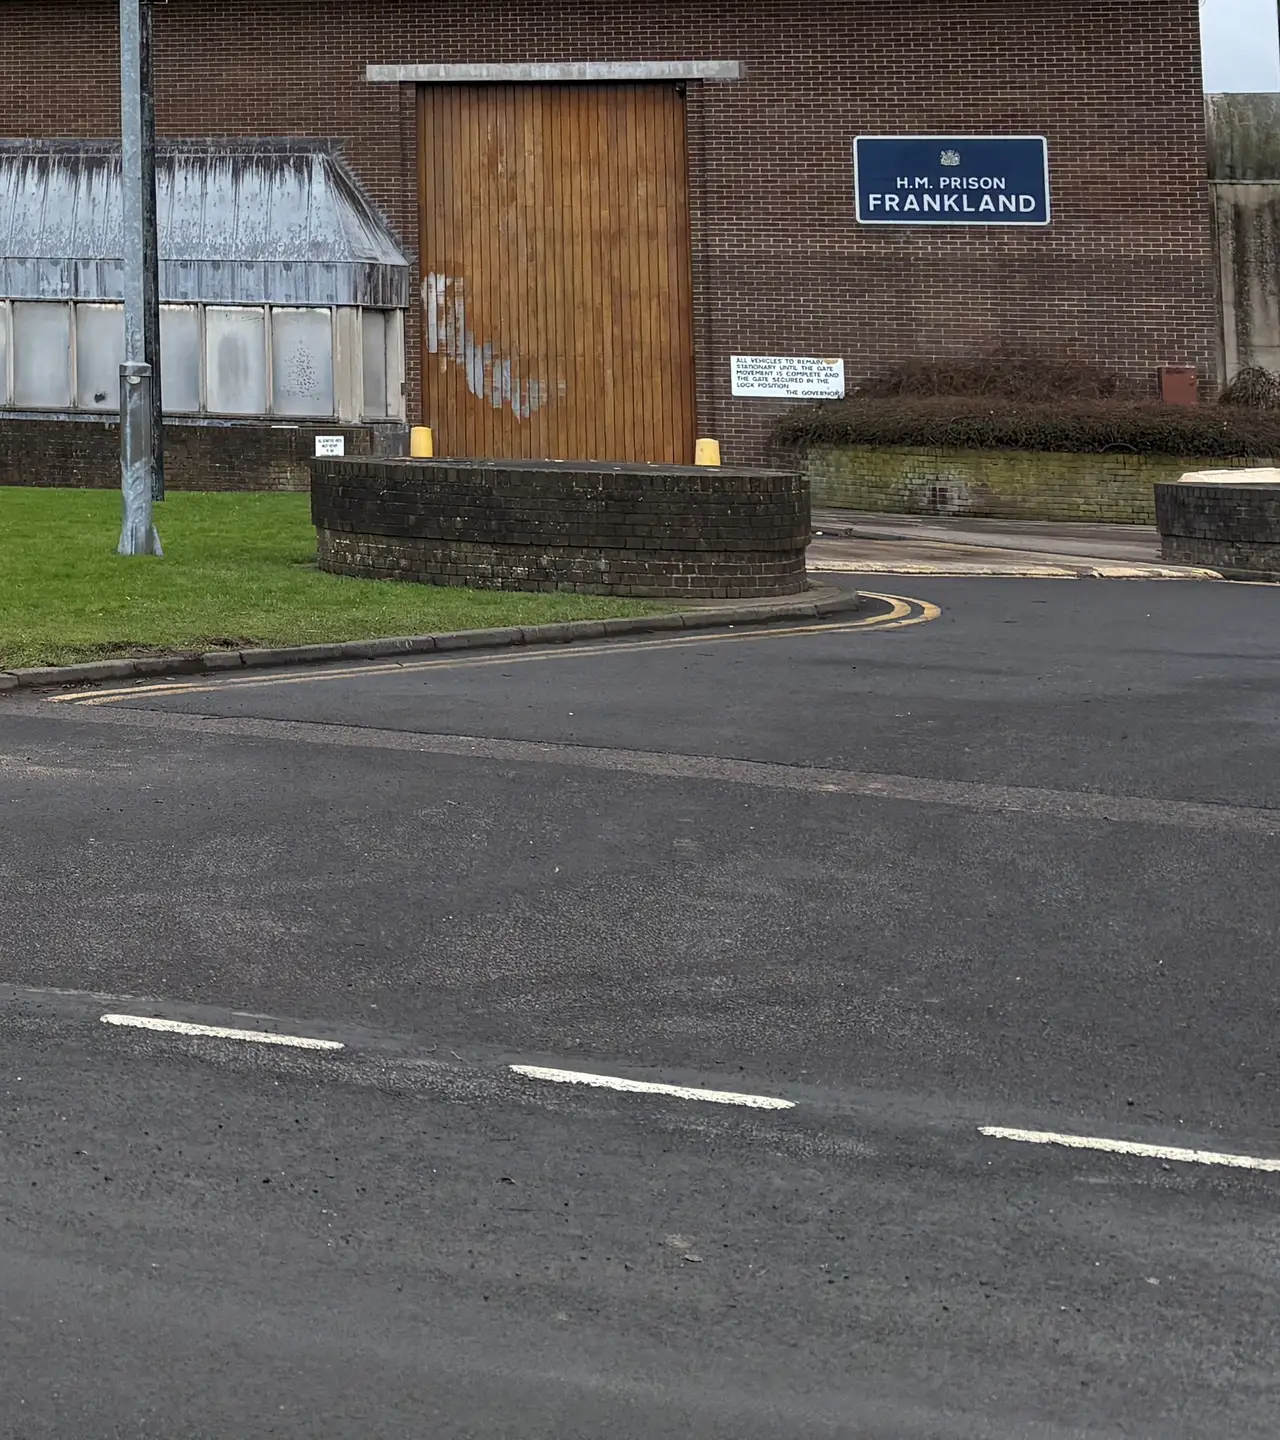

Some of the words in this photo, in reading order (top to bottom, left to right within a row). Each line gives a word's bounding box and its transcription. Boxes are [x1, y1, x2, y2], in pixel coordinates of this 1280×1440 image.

[896, 177, 933, 189] H.M.
[940, 177, 1006, 190] PRISON
[868, 194, 1036, 212] FRANKLAND
